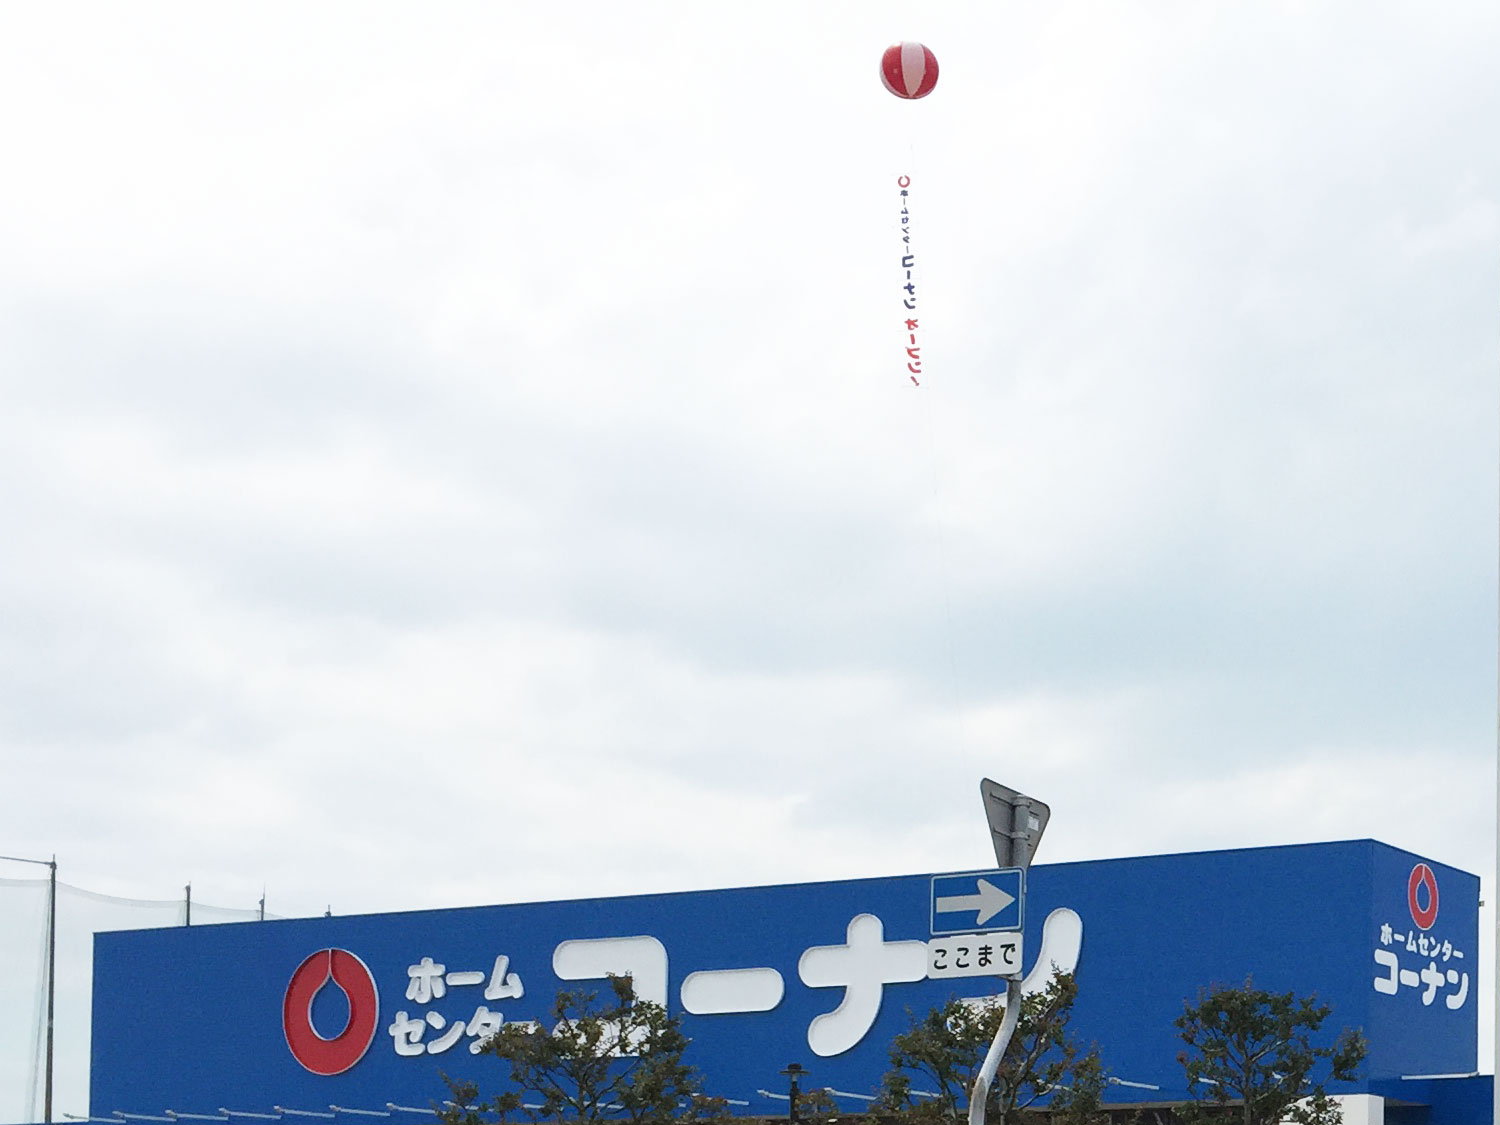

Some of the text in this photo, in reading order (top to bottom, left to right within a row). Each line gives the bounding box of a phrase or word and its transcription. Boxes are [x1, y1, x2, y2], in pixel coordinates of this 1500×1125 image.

[933, 943, 1017, 970] ここまで
[1380, 923, 1464, 961] ホームセンター
[404, 955, 524, 1003] ホーム
[1374, 949, 1469, 1009] コーナン
